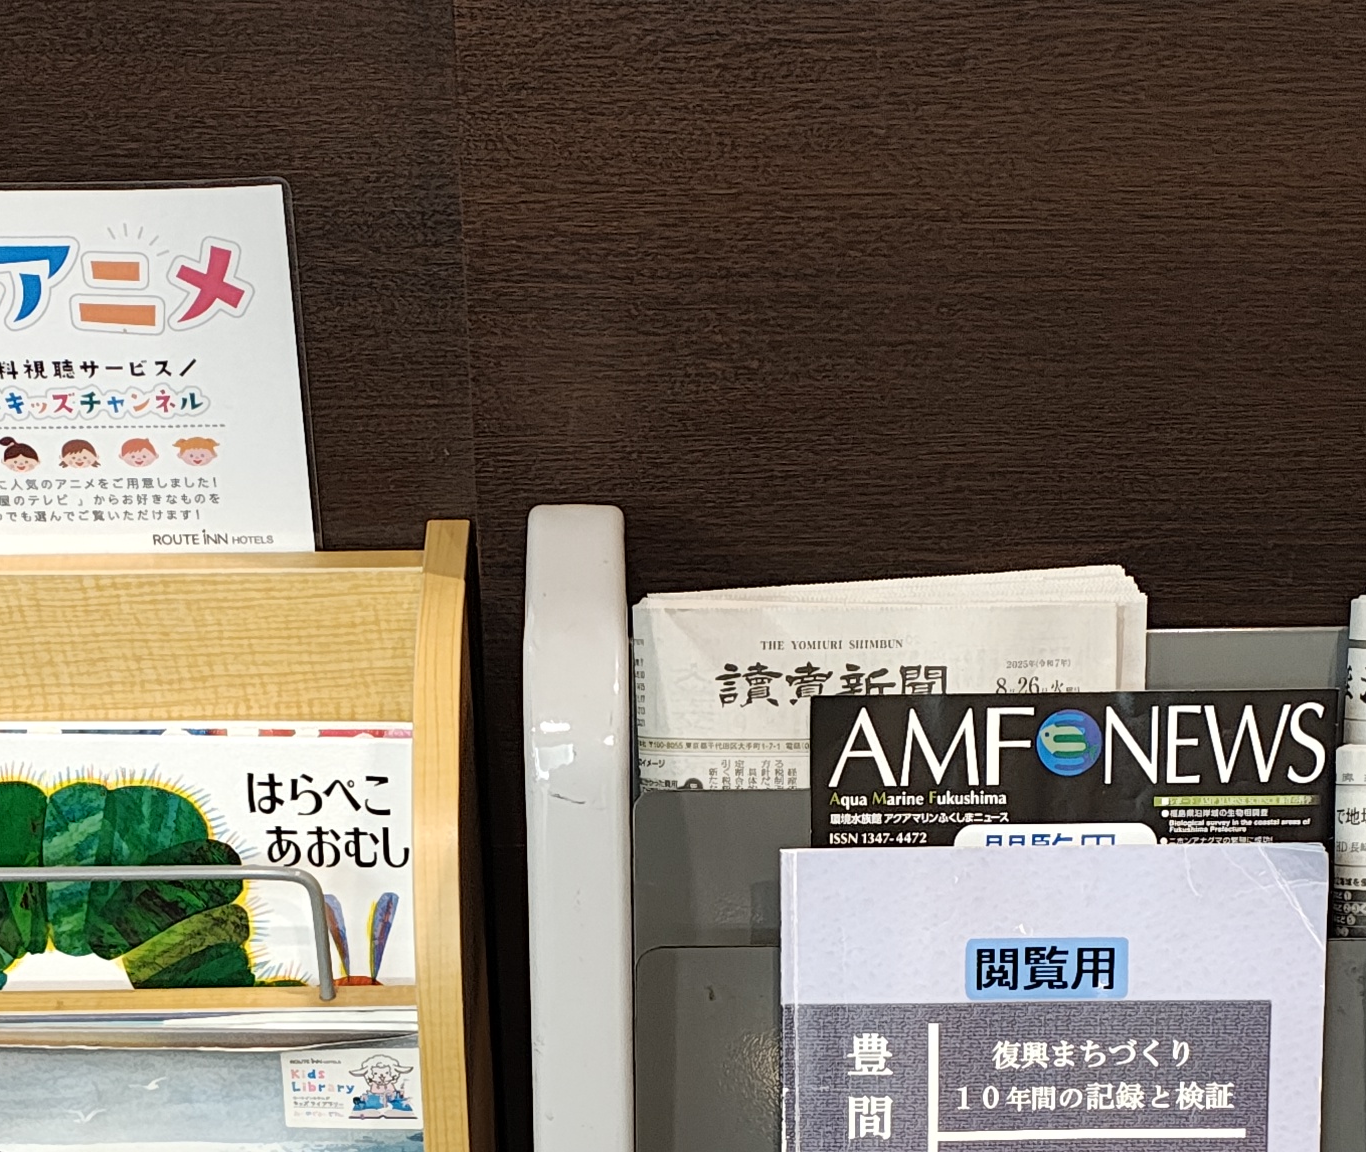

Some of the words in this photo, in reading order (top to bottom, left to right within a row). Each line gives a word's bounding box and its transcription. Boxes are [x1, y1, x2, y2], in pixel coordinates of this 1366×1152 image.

[153, 533, 200, 546] ROUTE
[232, 536, 274, 545] HOTELS
[760, 641, 785, 651] THE
[791, 639, 844, 651] YOMIURI
[849, 638, 903, 650] SHIMBUN
[829, 704, 1035, 787] AMF
[1104, 701, 1326, 786] NEWS
[247, 772, 392, 816] はらぺこ
[830, 793, 868, 810] Aqua
[872, 793, 924, 806] Marine
[929, 791, 1007, 806] Fukushima
[830, 813, 882, 825] 環境水族館
[884, 812, 1010, 824] アクアマリンふくしまニュース
[829, 833, 858, 844] ISSN
[862, 832, 927, 844] 1347-4472
[266, 825, 410, 869] あおむし
[974, 946, 1117, 992] 閲覧用
[992, 1039, 1192, 1071] 復興まちづくり
[291, 1069, 325, 1079] Kids
[291, 1082, 355, 1094] Library
